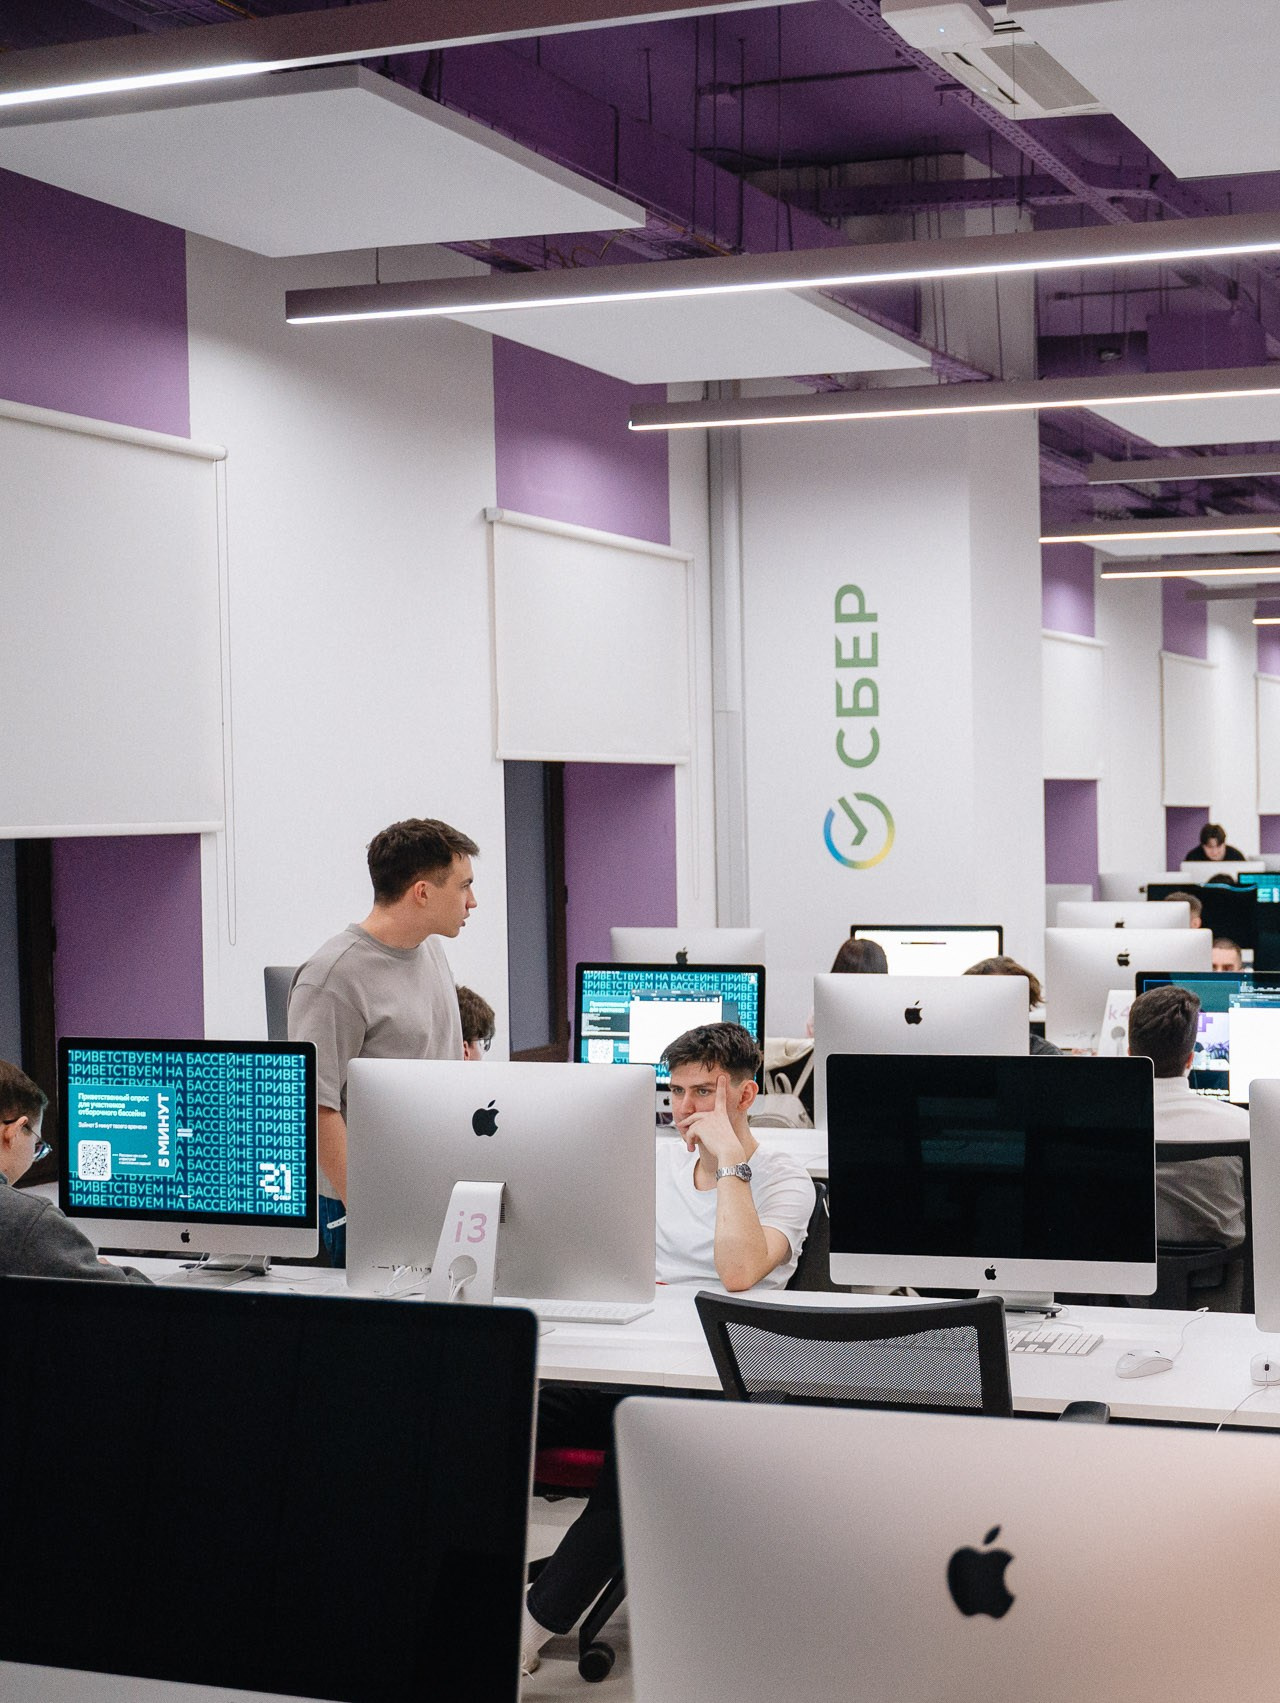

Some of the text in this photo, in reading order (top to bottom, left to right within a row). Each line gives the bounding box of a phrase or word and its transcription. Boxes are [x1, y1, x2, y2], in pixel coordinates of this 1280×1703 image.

[835, 584, 880, 768] СБЕР
[655, 982, 668, 990] НА
[720, 982, 758, 991] ПРИВЕТ
[166, 1053, 184, 1064] НА
[187, 1053, 253, 1066] БАССЕЙНЕ
[255, 1055, 306, 1067] ПРИВЕТ
[166, 1066, 184, 1077] НА
[187, 1066, 253, 1079] БАССЕЙНЕ
[255, 1068, 306, 1080] ПРИВЕТ
[187, 1079, 253, 1092] БАССЕЙНЕ
[255, 1082, 306, 1094] ПРИВЕТ
[187, 1092, 253, 1106] БАССЕЙНЕ
[255, 1095, 306, 1107] ПРИВЕТ
[187, 1106, 253, 1119] БАССЕЙНЕ
[255, 1108, 306, 1120] ПРИВЕТ
[158, 1093, 170, 1167] 5 МИНУТ
[187, 1119, 253, 1132] БАССЕЙНЕ
[255, 1122, 306, 1134] ПРИВЕТ
[255, 1135, 306, 1147] ПРИВЕТ
[187, 1145, 253, 1159] БАССЕЙНЕ
[255, 1148, 306, 1160] ПРИВЕТ
[187, 1159, 253, 1172] БАССЕЙНЕ
[187, 1172, 253, 1186] БАССЕЙНЕ
[260, 1163, 292, 1193] 21
[167, 1185, 184, 1195] НА
[187, 1185, 253, 1199] БАССЕЙНЕ
[167, 1198, 184, 1209] НА
[187, 1198, 254, 1213] БАССЕЙНЕ
[256, 1202, 306, 1214] ПРИВЕТ
[454, 1211, 487, 1244] i3
